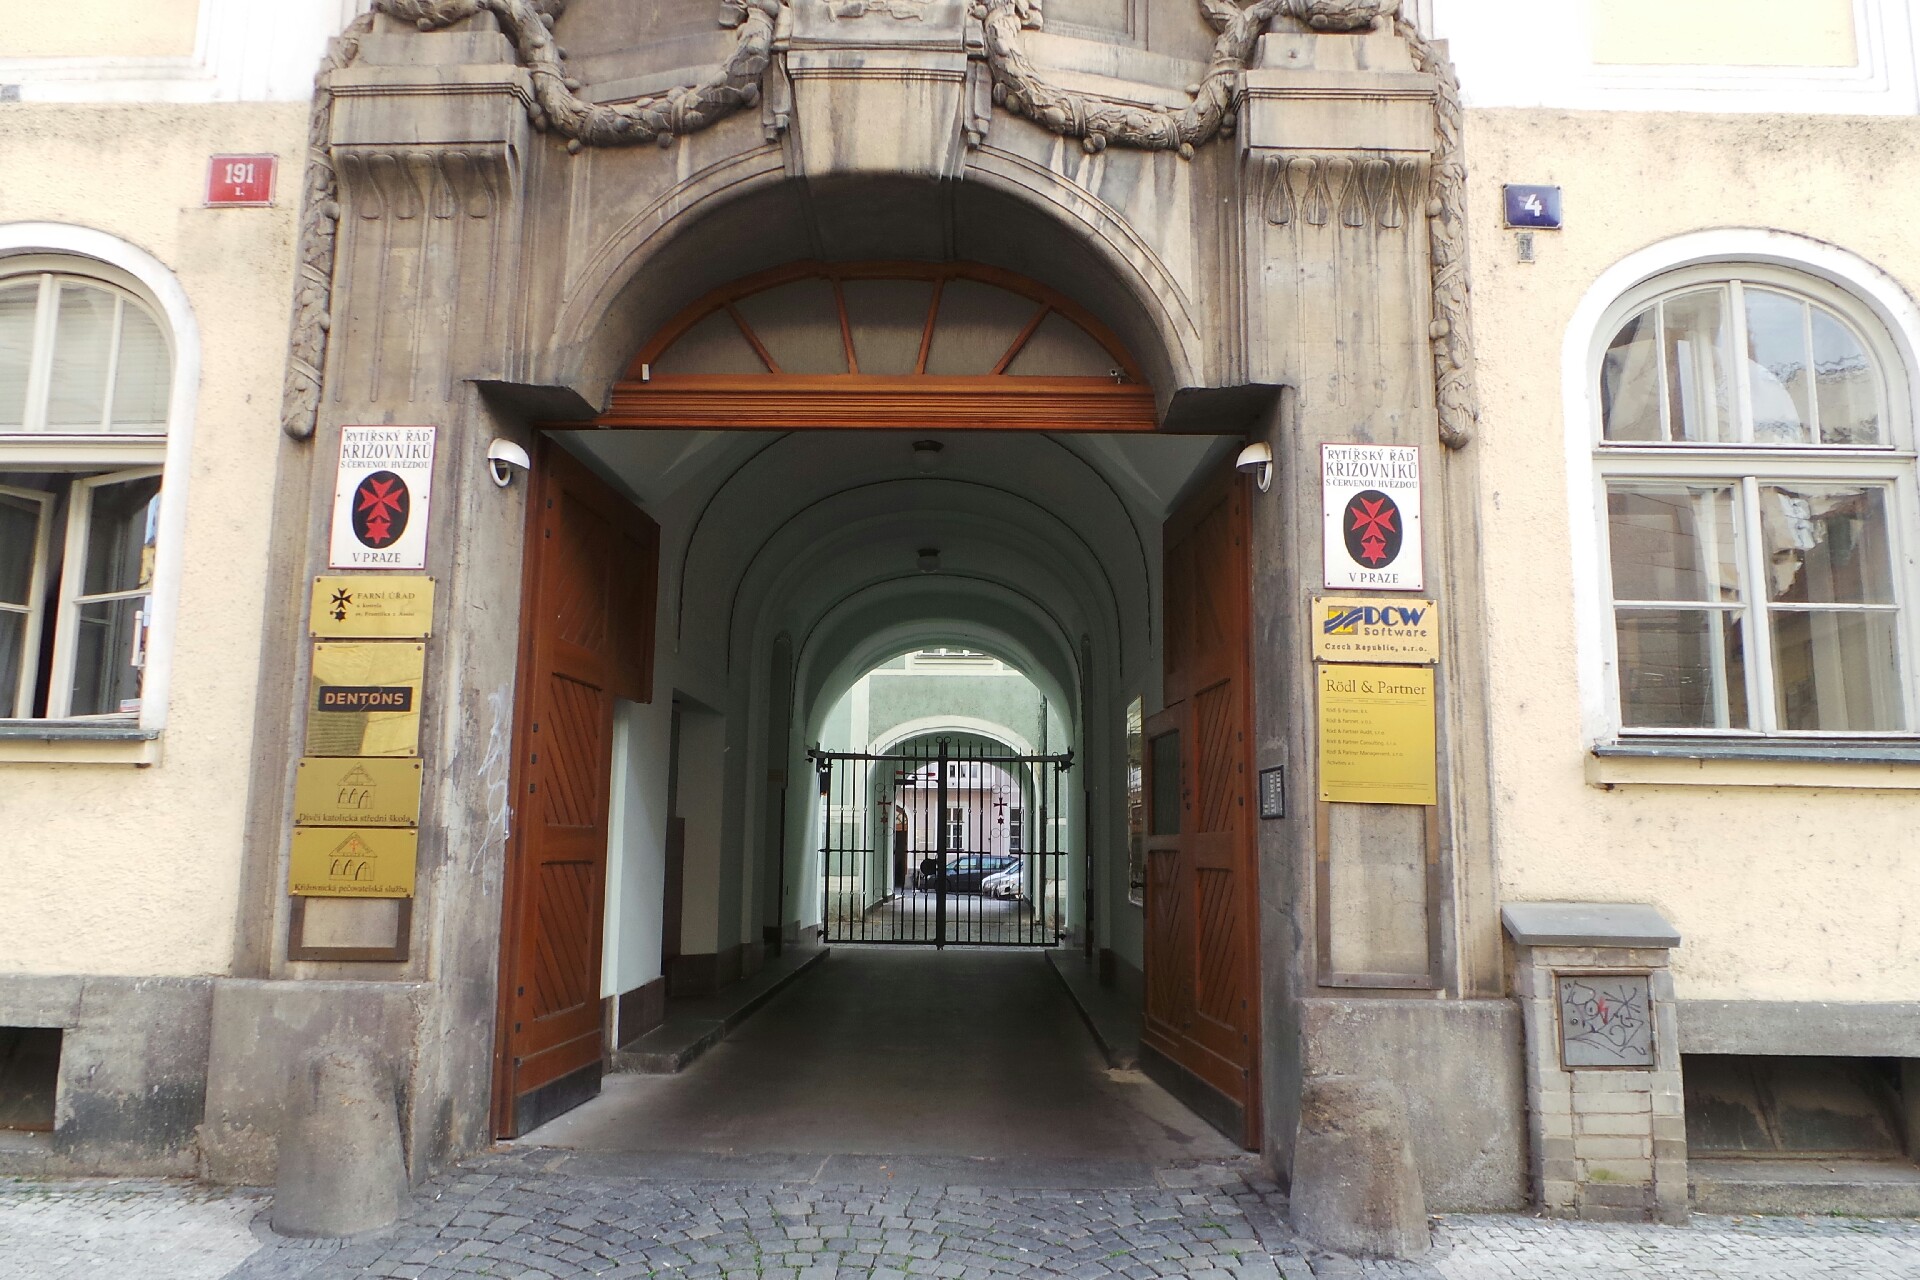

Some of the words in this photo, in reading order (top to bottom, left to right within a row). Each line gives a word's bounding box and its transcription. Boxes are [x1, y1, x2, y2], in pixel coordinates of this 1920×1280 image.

[225, 163, 254, 184] 191
[1524, 194, 1542, 217] 4
[346, 429, 400, 441] RYTÍŘSKÝ
[406, 429, 430, 441] ŘÁD
[342, 442, 432, 459] KŘIŽOVNÍKŮ
[1328, 448, 1384, 461] RYTÍŘSKÝ
[1389, 449, 1414, 462] ŘÁD
[340, 461, 346, 469] S
[347, 459, 389, 469] ČERVENOU
[1326, 460, 1417, 479] KŘIŽOVNÍKŮ
[1326, 479, 1331, 487] S
[1332, 477, 1376, 488] ČERVENOU
[1378, 479, 1418, 489] HVĚZDOU
[353, 553, 360, 563] V
[363, 553, 401, 563] PRAZE
[1349, 573, 1357, 583] V
[1360, 573, 1399, 584] PRAZE
[357, 591, 385, 600] FARNÍ
[388, 591, 416, 600] ÚŘAD
[1364, 606, 1426, 626] DCW
[1364, 627, 1428, 637] Software
[1355, 644, 1398, 652] Republic,
[1326, 679, 1356, 693] Rödl
[1361, 680, 1374, 693] &
[1378, 681, 1427, 695] Partner
[325, 693, 404, 705] DENTONS
